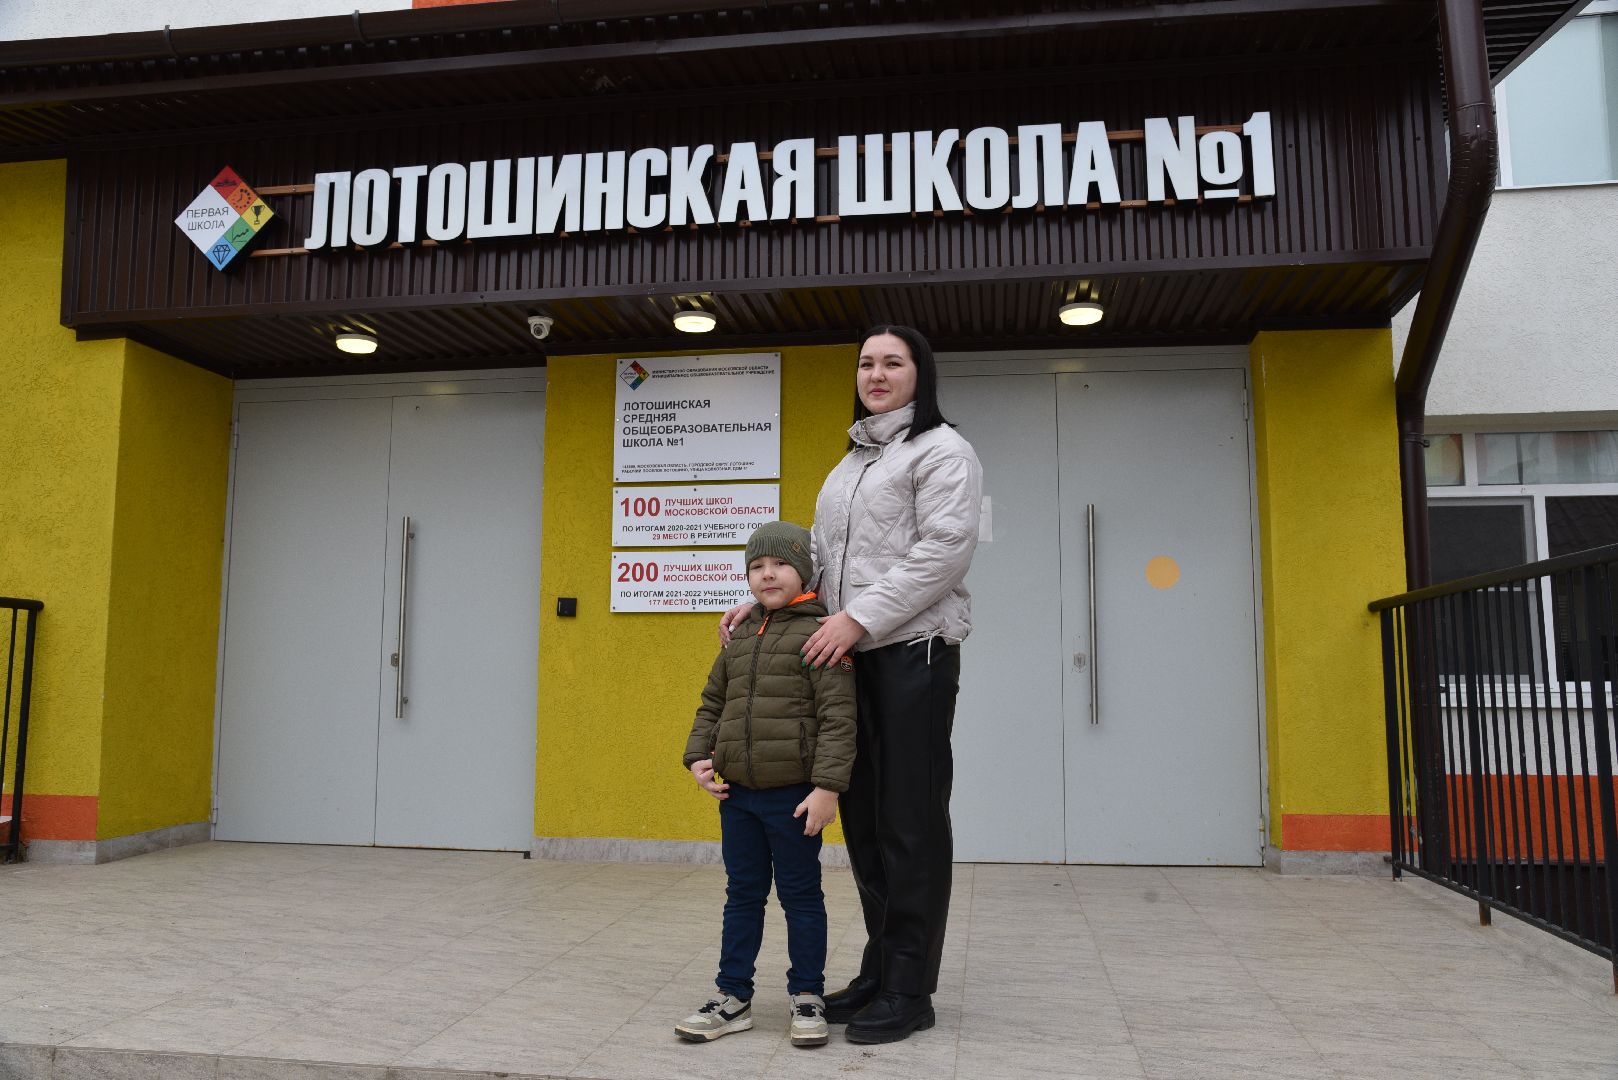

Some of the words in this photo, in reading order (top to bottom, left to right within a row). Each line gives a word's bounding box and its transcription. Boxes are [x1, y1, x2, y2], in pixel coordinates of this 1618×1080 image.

[304, 138, 815, 251] ЛОТОШИНСКАЯ
[838, 121, 1122, 216] ШКОЛА
[1145, 111, 1276, 201] №1
[186, 206, 229, 218] ПЕРВАЯ
[187, 220, 226, 231] ШКОЛА
[623, 399, 711, 411] ЛОТОШИНСКАЯ
[623, 413, 676, 424] СРЕДНЯЯ
[622, 422, 772, 436] ОБЩЕОБРАЗОВАТЕЛЬНАЯ
[622, 438, 664, 448] ШКОЛА
[666, 437, 685, 447] №1
[620, 496, 661, 518] 100
[664, 497, 704, 506] ЛУЧШИХ
[706, 497, 733, 505] ШКОЛ
[664, 506, 728, 517] МОСКОВСКОЙ
[730, 506, 775, 515] ОБЛАСТИ
[667, 524, 702, 532] 2020-2021
[704, 523, 746, 531] УЧЕБНОГО
[747, 522, 763, 530] ГОД
[652, 533, 661, 541] 29
[697, 531, 737, 539] РЕЙТИНГЕ
[617, 562, 659, 583] 200
[663, 564, 703, 572] ЛУЧШИХ
[704, 563, 733, 571] ШКОЛ
[663, 573, 727, 582] МОСКОВСКОЙ
[665, 590, 702, 598] 2021-2022
[703, 589, 746, 597] УЧЕБНОГО
[698, 597, 739, 606] РЕЙТИНГЕ
